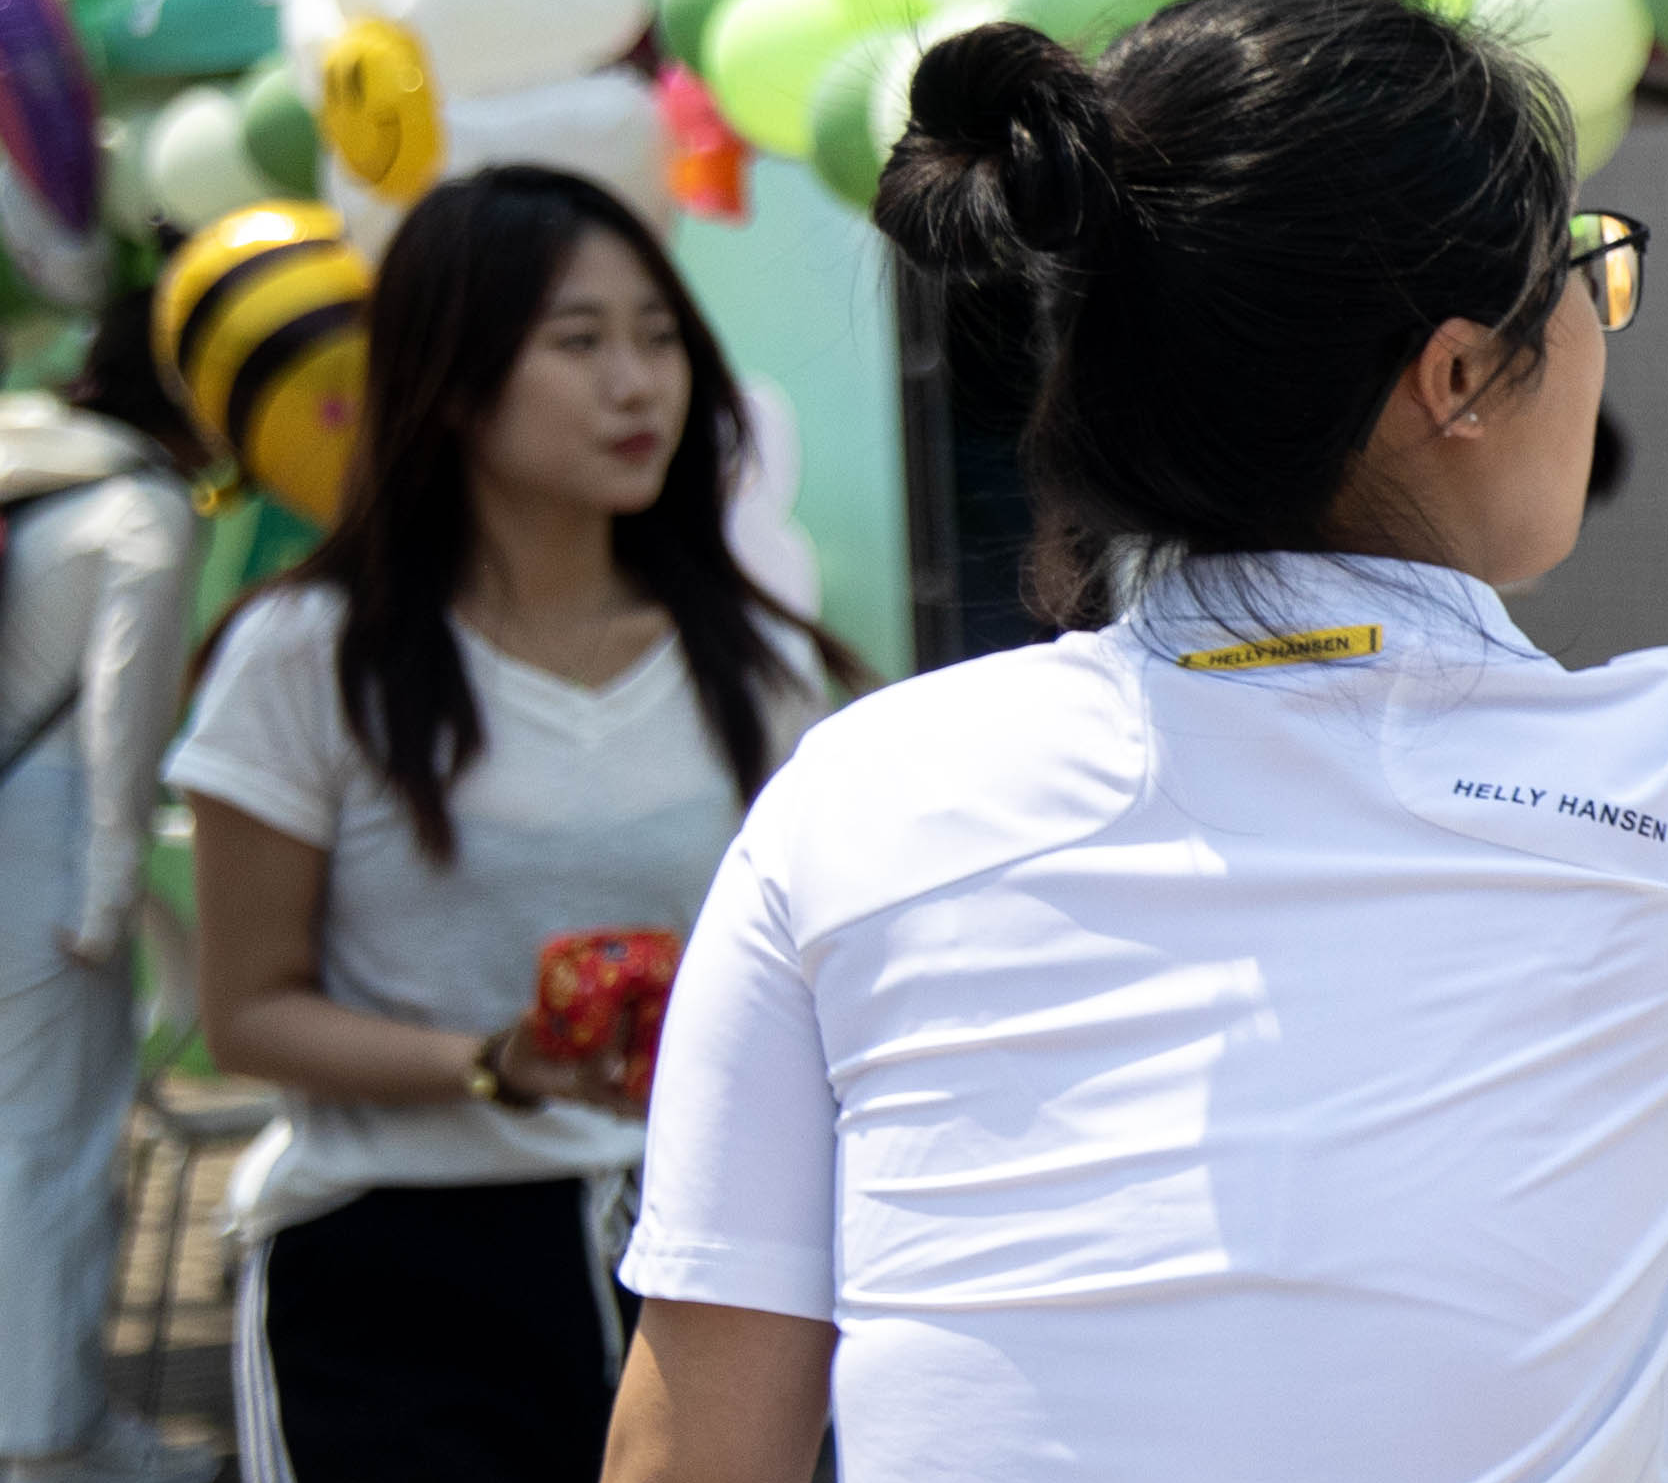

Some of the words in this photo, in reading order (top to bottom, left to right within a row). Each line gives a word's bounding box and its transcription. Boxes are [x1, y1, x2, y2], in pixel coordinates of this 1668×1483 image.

[1208, 649, 1264, 666] HELLY
[1271, 636, 1350, 660] HANSEN
[1453, 778, 1547, 807] HELLY
[1558, 794, 1668, 842] HANSEN
